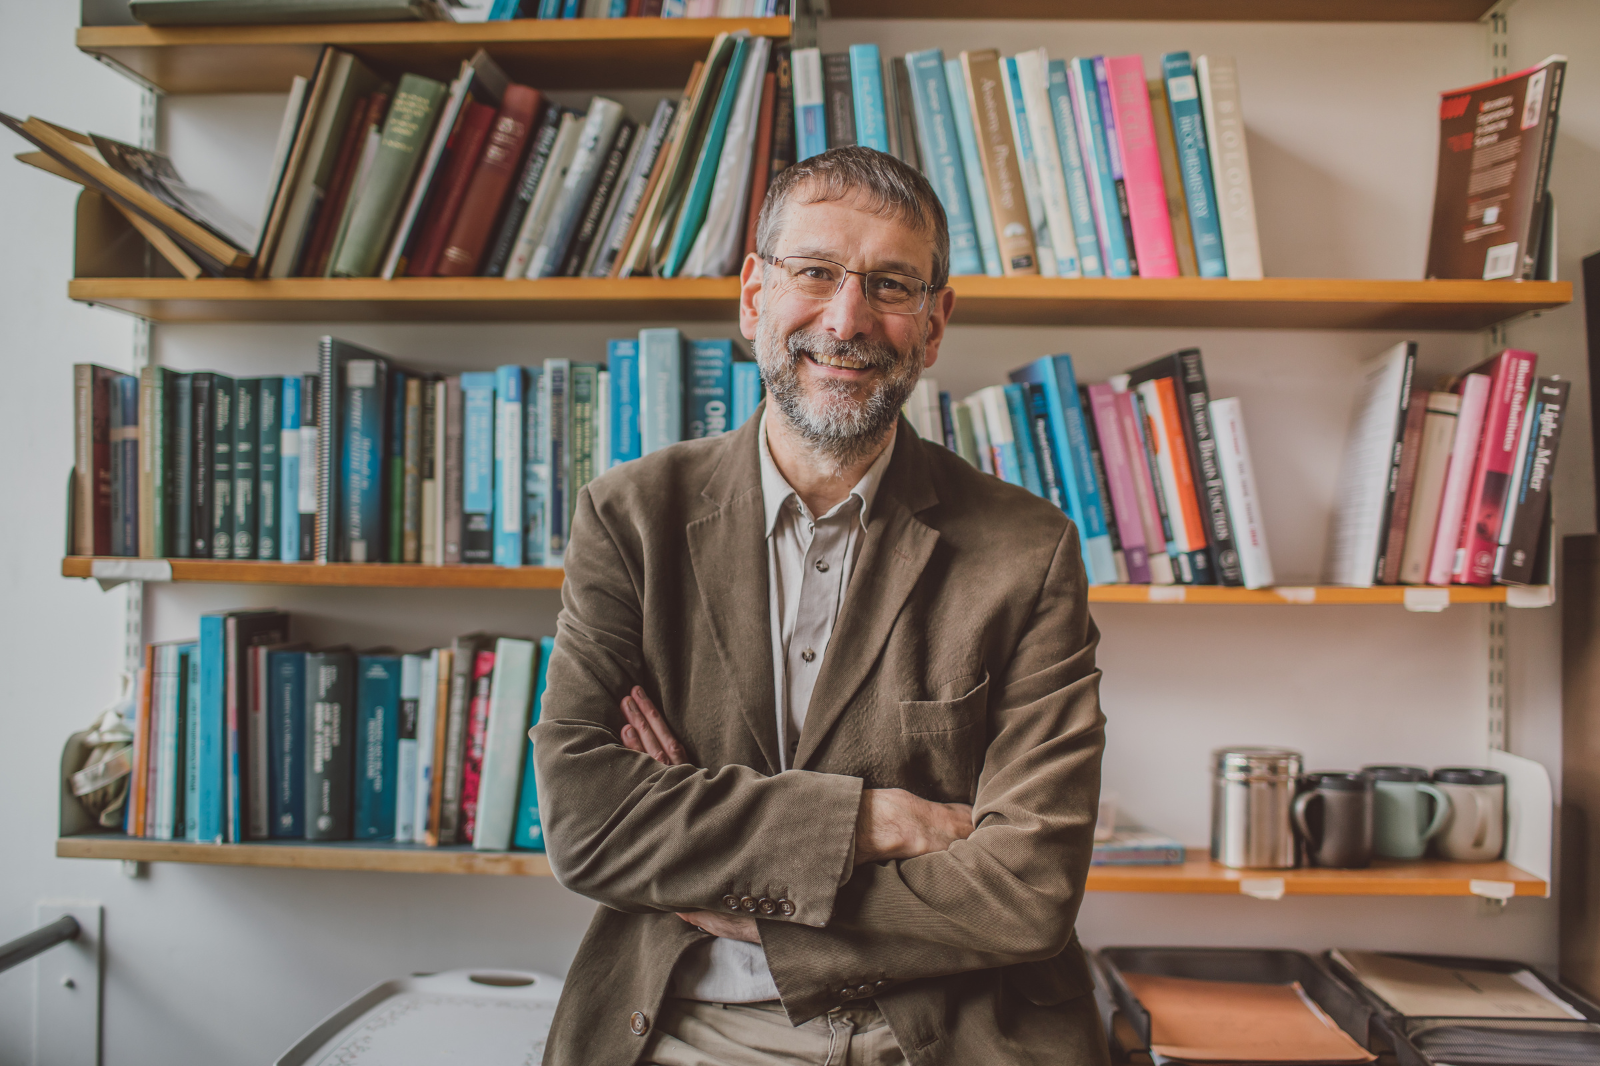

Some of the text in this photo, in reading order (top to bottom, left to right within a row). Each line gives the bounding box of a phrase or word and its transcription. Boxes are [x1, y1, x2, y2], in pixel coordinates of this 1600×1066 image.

[980, 77, 1000, 132] Anatomy
[993, 145, 1014, 208] Physiology
[1122, 110, 1142, 154] CELL
[1218, 101, 1248, 221] BIOLOGY
[1178, 115, 1209, 218] BIOCHEMISTRY
[617, 358, 633, 453] Inorganic Chemistry
[1516, 360, 1530, 390] Blood
[654, 371, 669, 443] Principles of
[1503, 391, 1523, 451] Substitutes
[1540, 403, 1559, 436] Light
[348, 388, 362, 538] NITRIC OXIDE RESEARCH
[1199, 439, 1217, 479] BRAIN
[1530, 448, 1551, 492] Matter
[1207, 479, 1229, 540] FUNCTION
